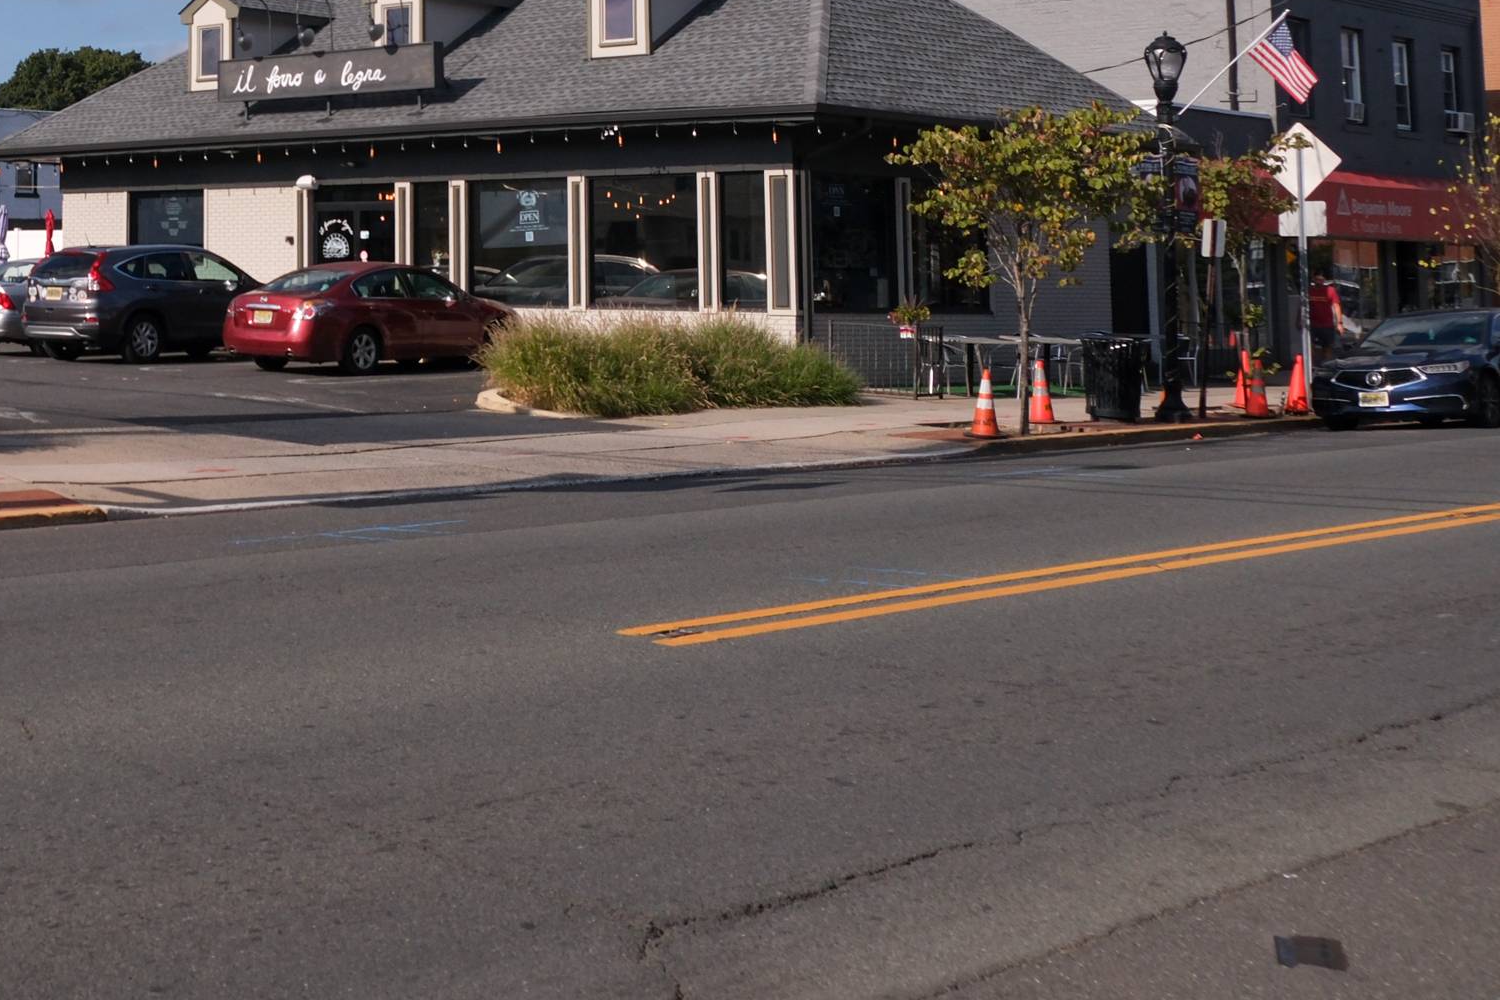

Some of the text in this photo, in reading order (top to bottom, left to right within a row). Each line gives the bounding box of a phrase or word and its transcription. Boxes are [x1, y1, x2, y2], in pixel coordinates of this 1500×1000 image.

[233, 64, 256, 94] il
[314, 68, 327, 85] a
[340, 60, 387, 91] legna
